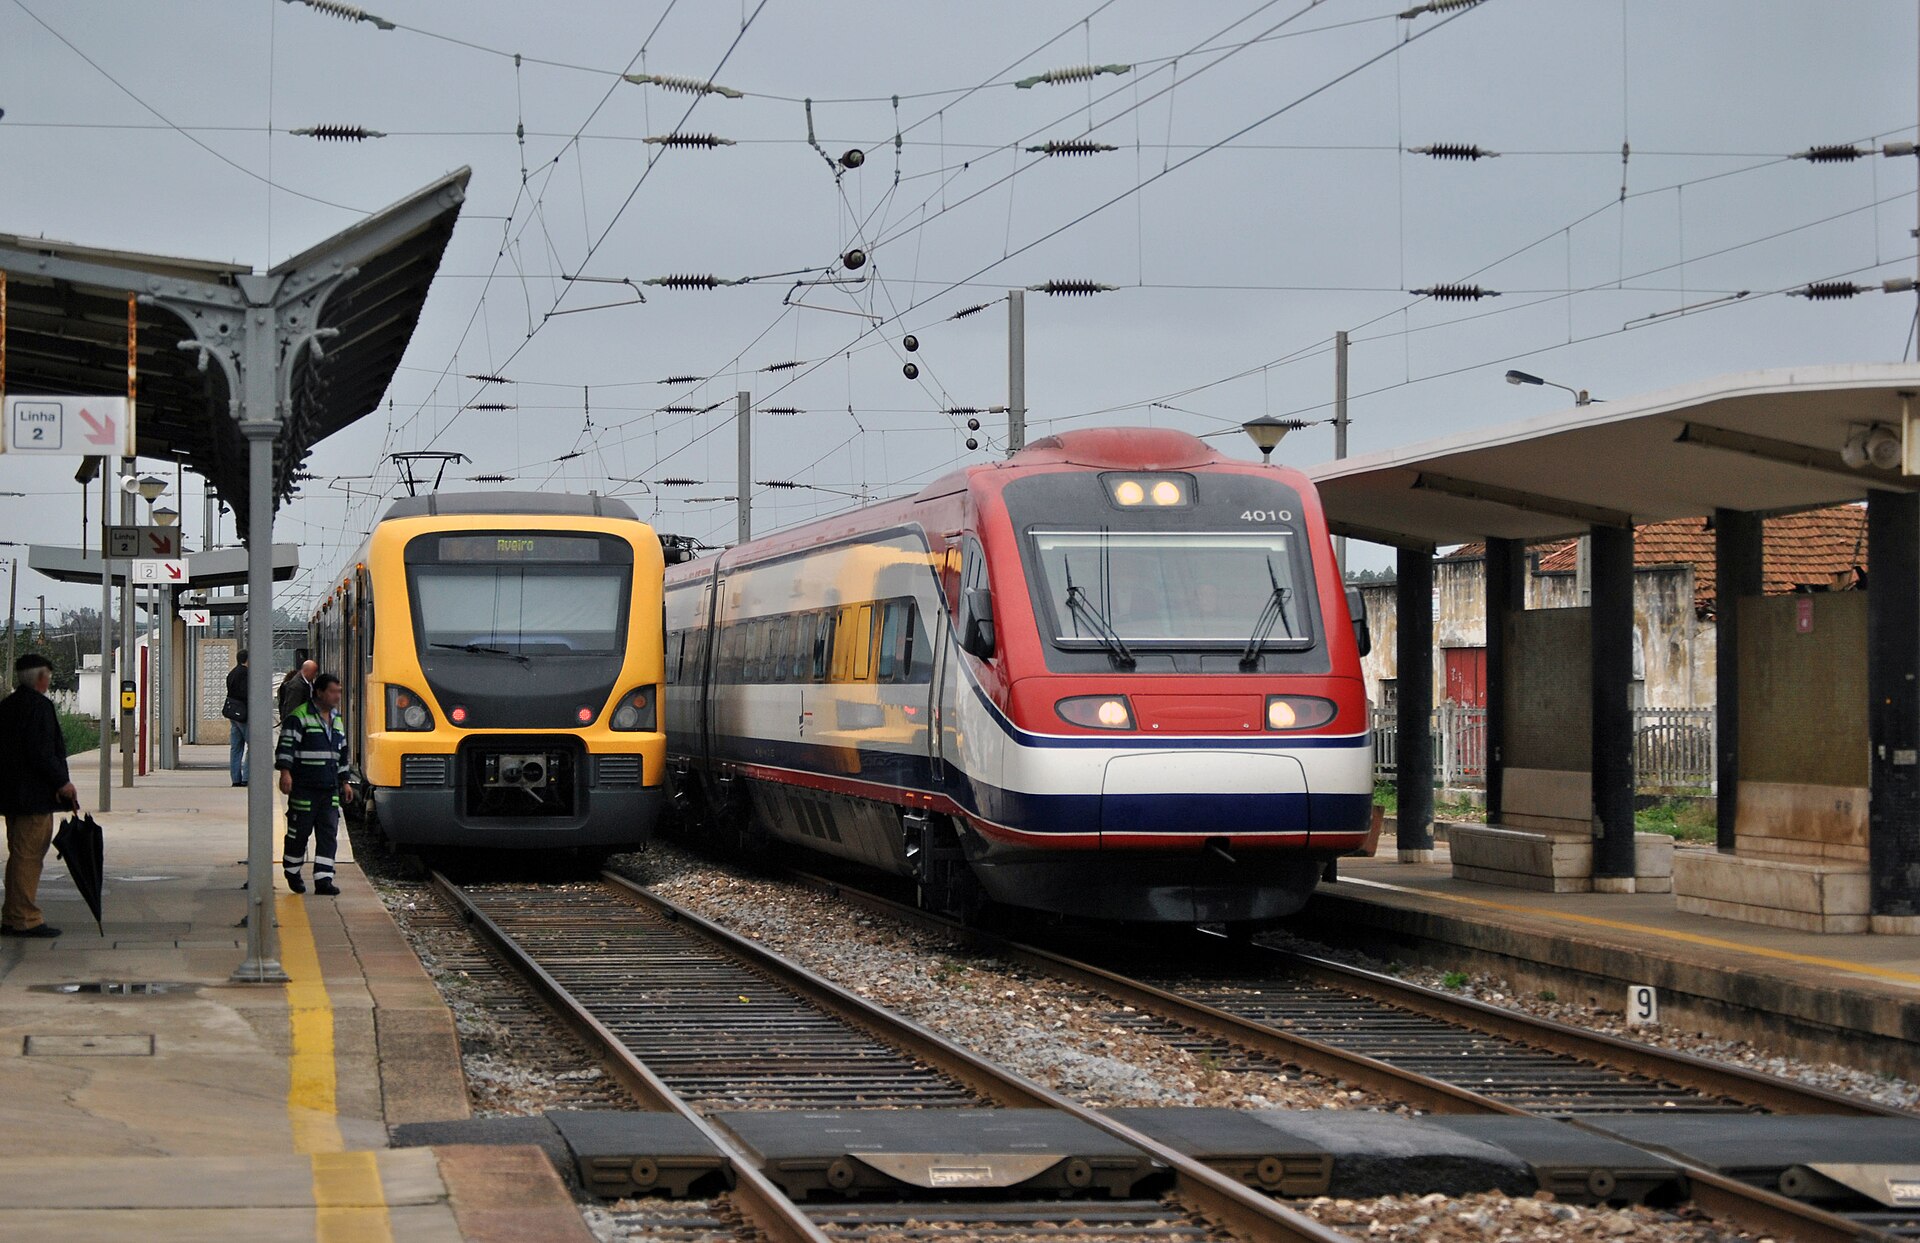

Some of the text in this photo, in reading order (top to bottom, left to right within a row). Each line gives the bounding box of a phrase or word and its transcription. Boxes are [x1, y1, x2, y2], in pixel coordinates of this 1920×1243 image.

[20, 410, 56, 423] Linha
[32, 427, 44, 441] 2
[1240, 510, 1292, 522] 4010
[121, 543, 128, 552] 2
[497, 539, 534, 552] Aveiro
[146, 568, 153, 578] 2
[1637, 988, 1652, 1020] 9
